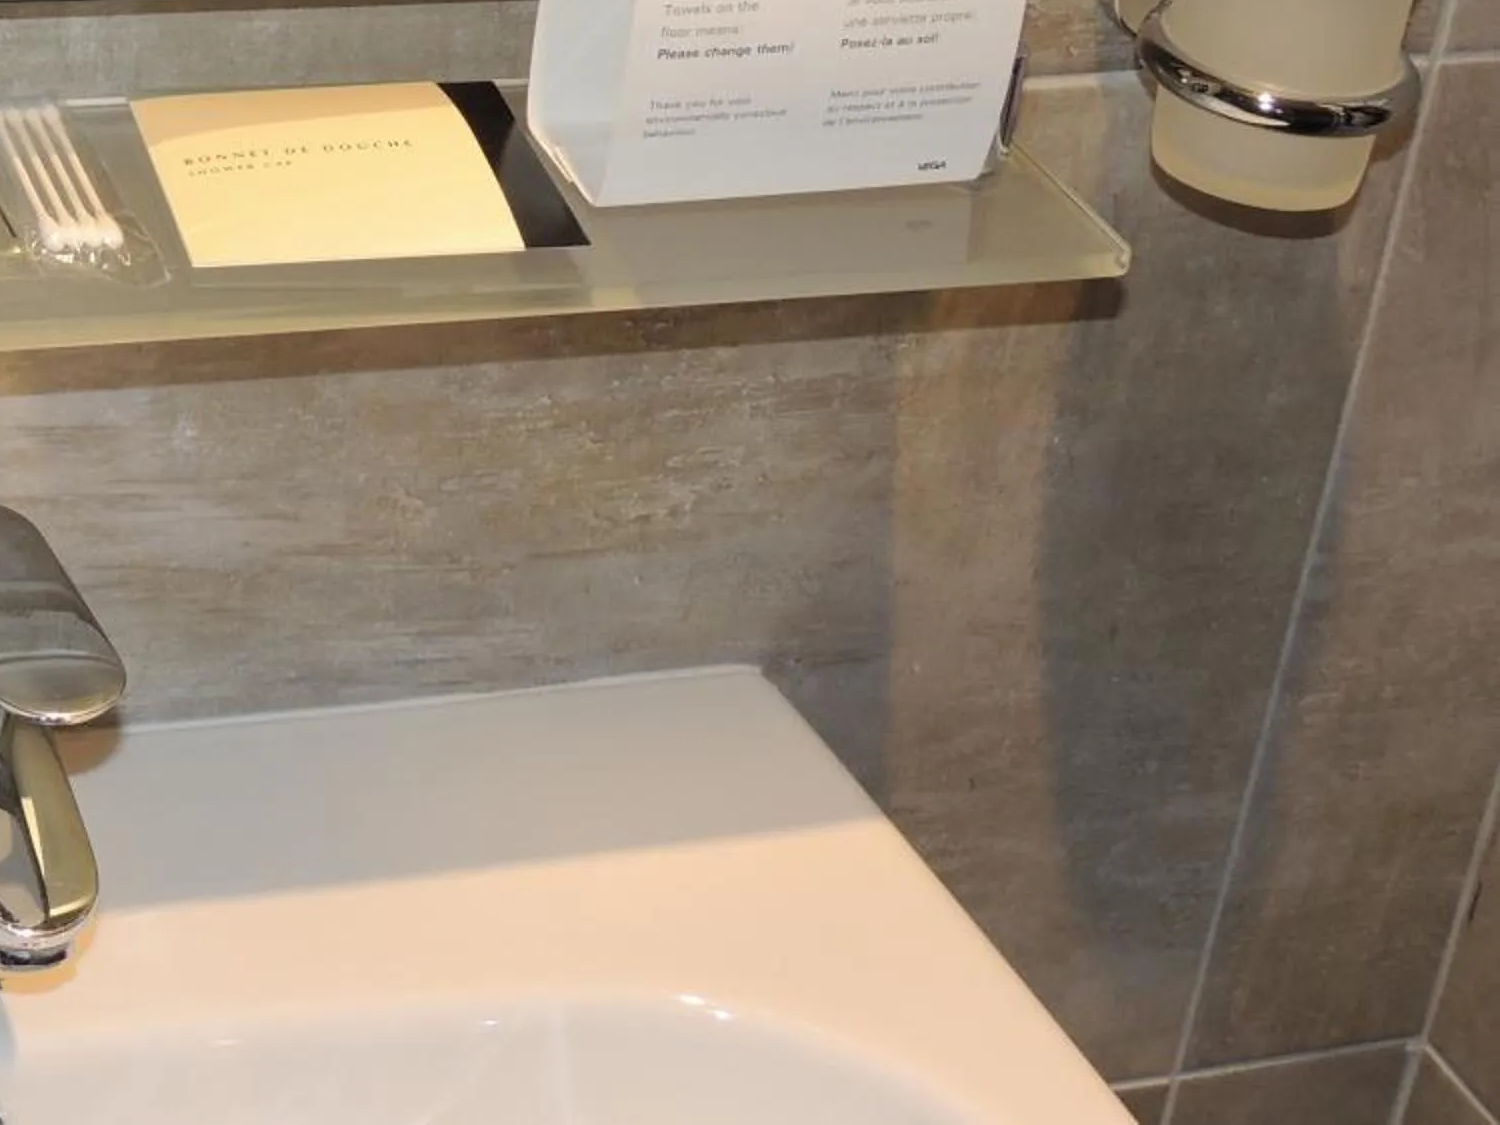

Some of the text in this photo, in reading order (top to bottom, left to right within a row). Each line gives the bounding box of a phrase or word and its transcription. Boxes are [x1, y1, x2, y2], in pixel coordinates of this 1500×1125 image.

[663, 0, 760, 17] Towels on the
[657, 48, 700, 60] Please
[704, 45, 752, 59] change
[184, 147, 269, 166] BONNET
[322, 139, 412, 154] DOUCHE
